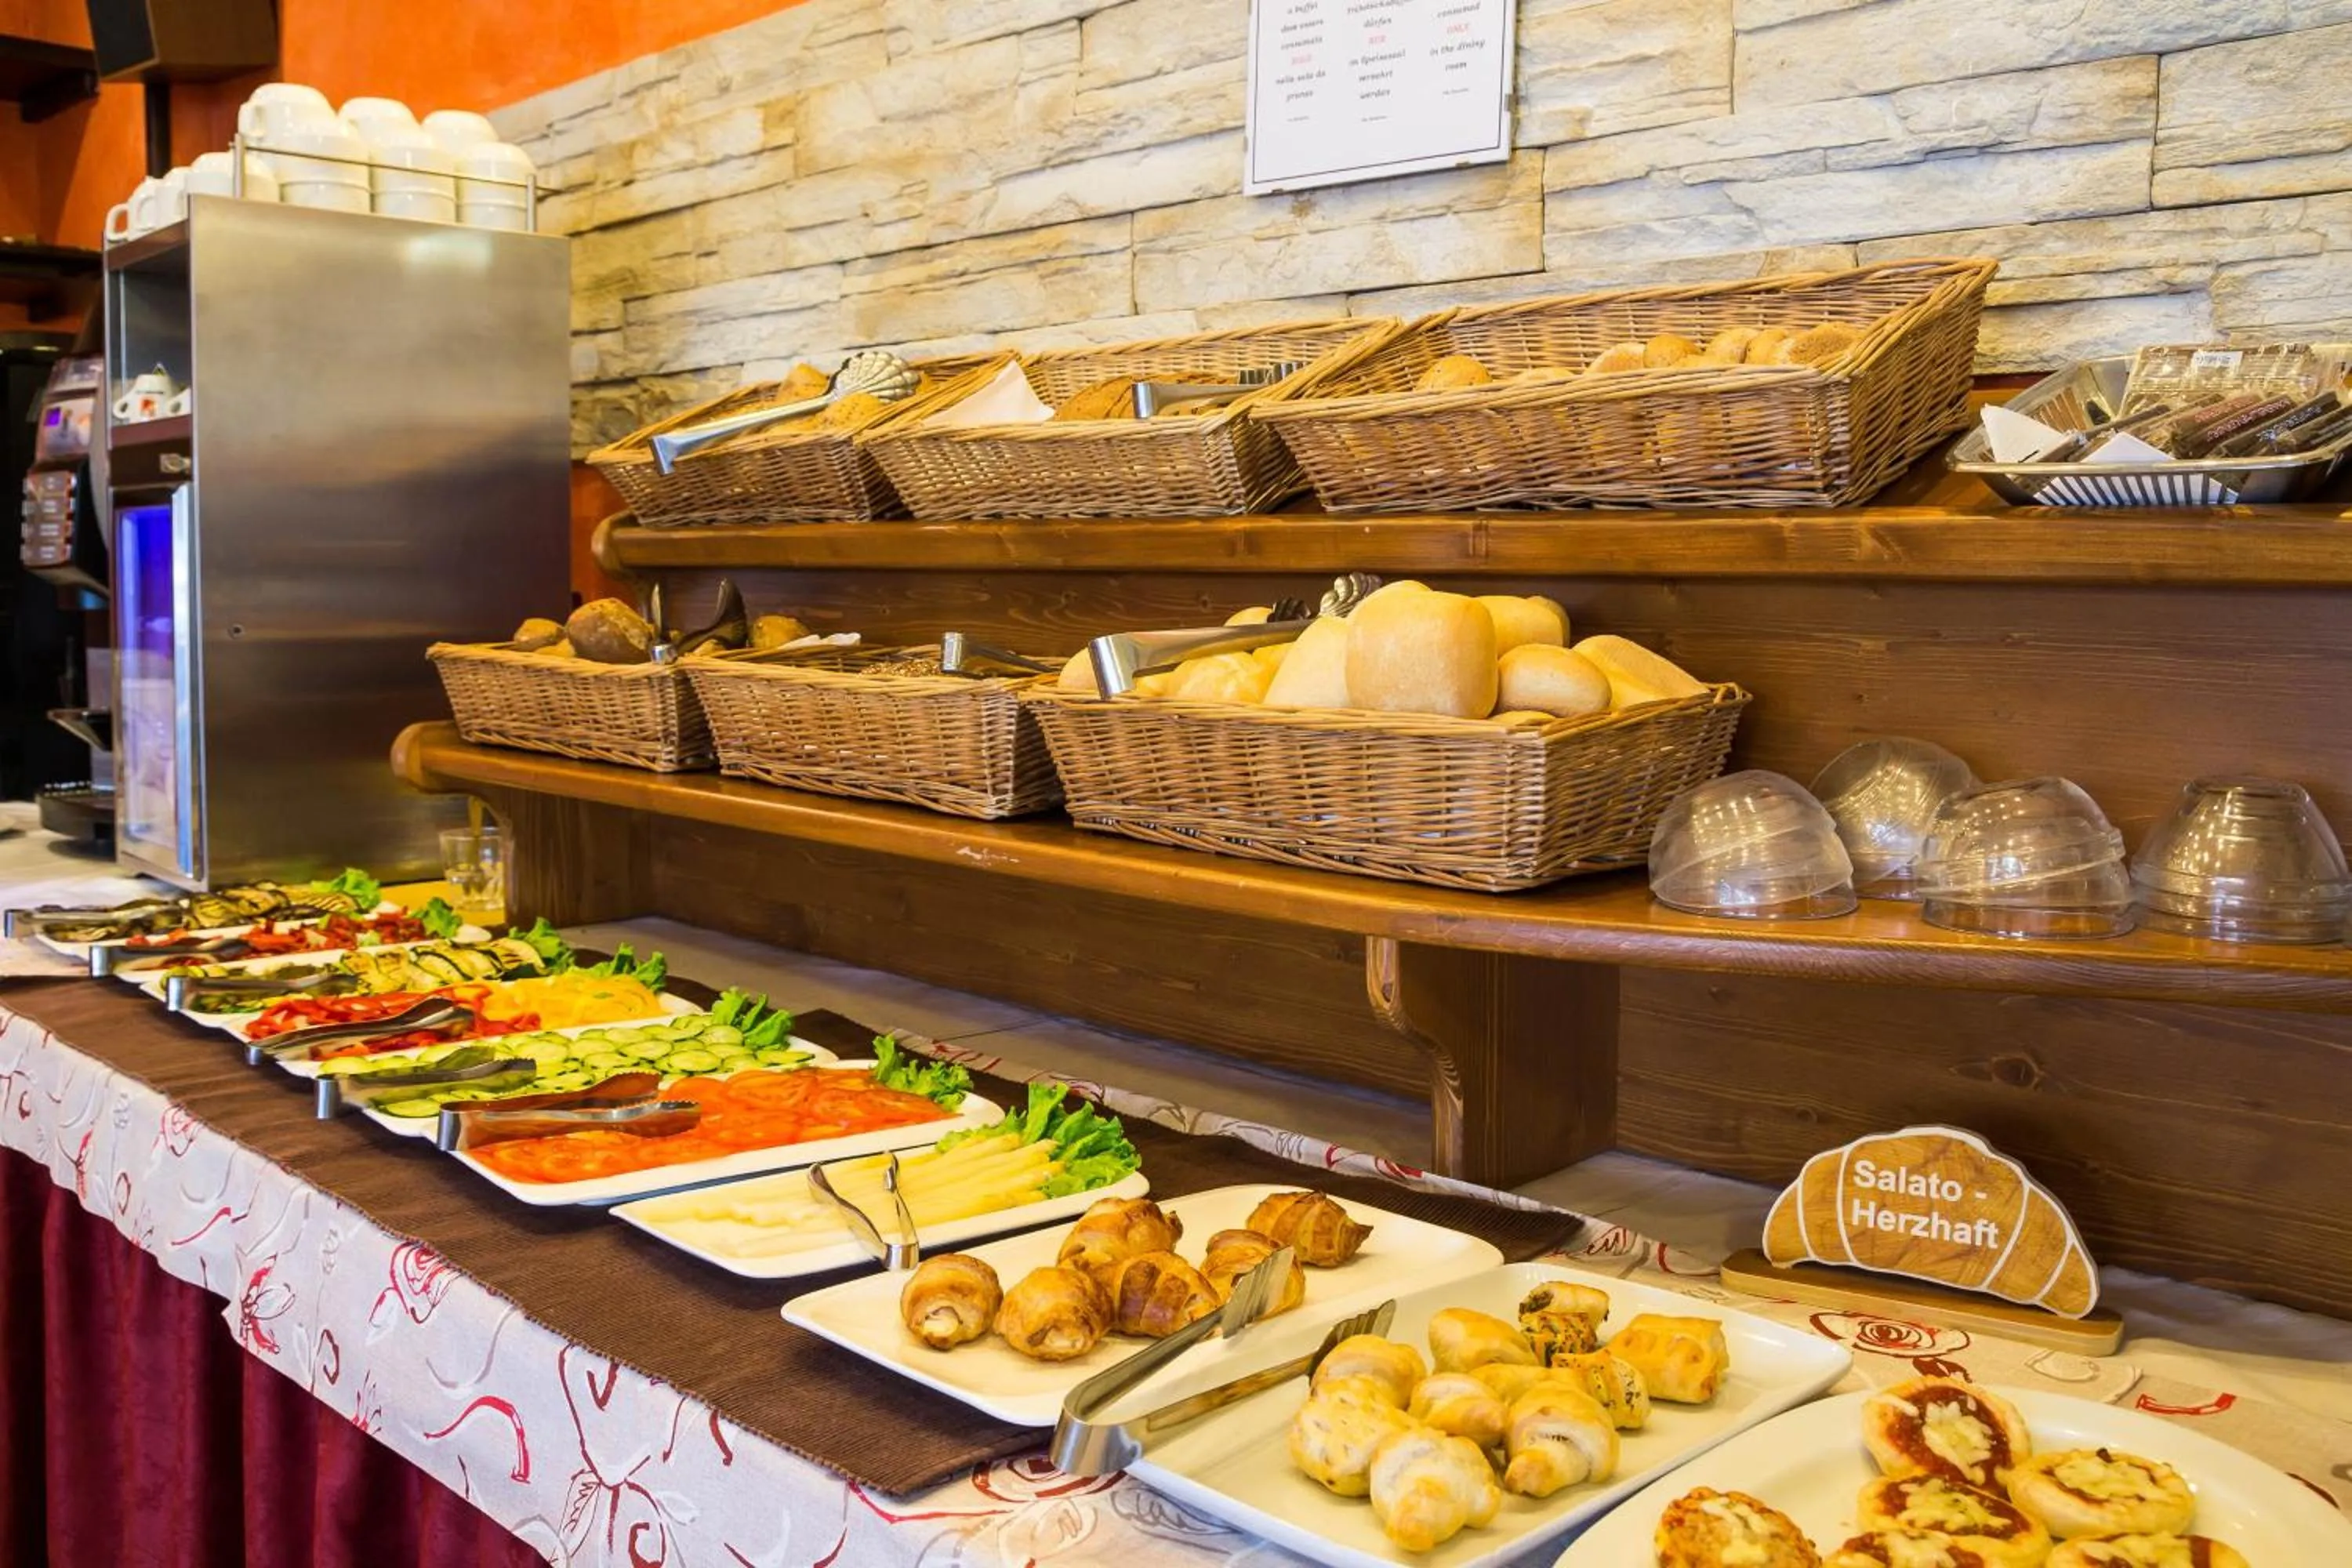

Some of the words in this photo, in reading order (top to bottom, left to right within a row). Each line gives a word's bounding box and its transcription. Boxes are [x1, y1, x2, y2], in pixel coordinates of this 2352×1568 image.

[1363, 16, 1392, 27] dürfen
[1441, 45, 1454, 54] the
[1457, 39, 1486, 50] dining
[1446, 62, 1467, 72] room
[1360, 89, 1390, 99] werden
[1853, 1160, 1963, 1202] Salato
[1851, 1199, 1999, 1249] Herzhaft
